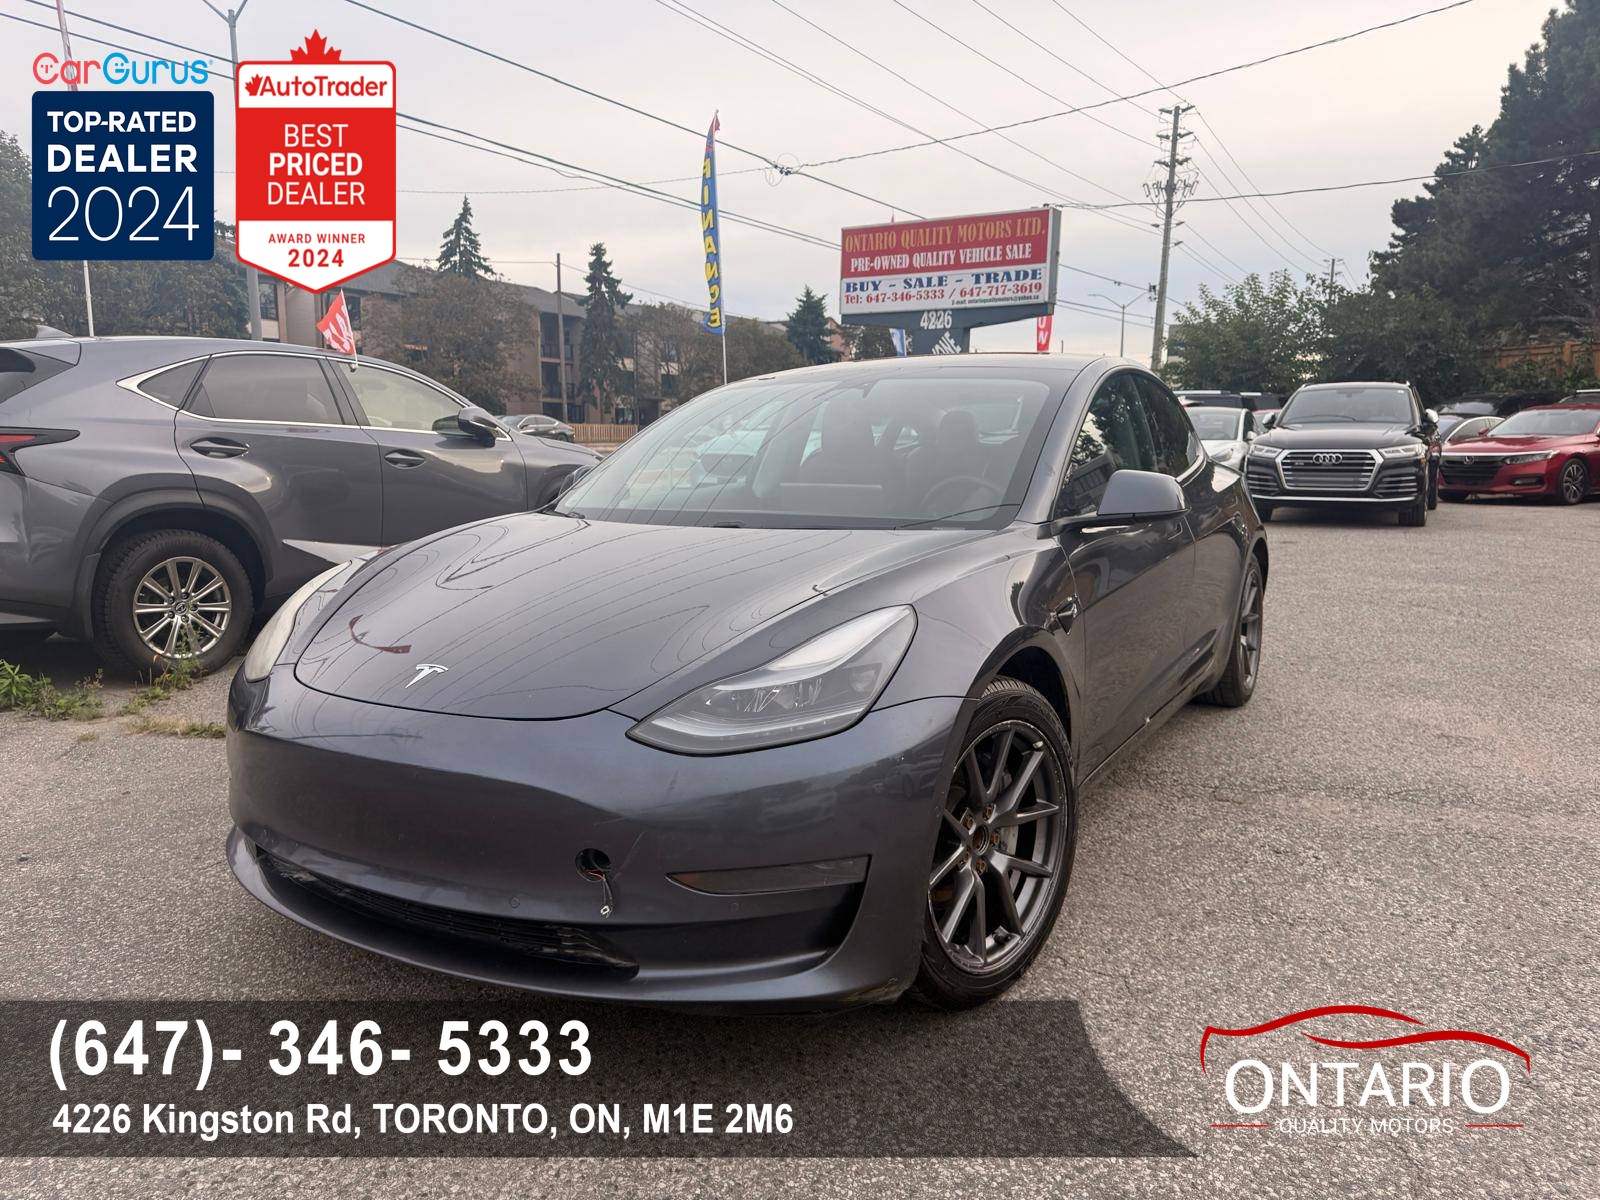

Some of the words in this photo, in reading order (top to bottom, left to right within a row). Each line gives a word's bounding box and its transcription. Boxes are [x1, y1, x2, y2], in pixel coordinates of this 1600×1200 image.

[845, 231, 897, 253] ONTARIO
[901, 225, 953, 249] QUALITY
[957, 220, 1012, 243] MOTORS
[1016, 217, 1046, 238] LTD.
[850, 254, 910, 272] PRE-OWNED
[912, 249, 957, 269] QUALITY
[959, 245, 1003, 264] VEHICLE
[1005, 242, 1032, 261] SALE
[844, 293, 863, 304] Tel:
[866, 288, 945, 303] 647-346-5333
[960, 282, 1042, 298] 647-717-3619
[845, 280, 882, 293] BUY
[903, 275, 948, 290] SALE
[971, 268, 1042, 285] TRADE
[920, 310, 953, 330] 4226
